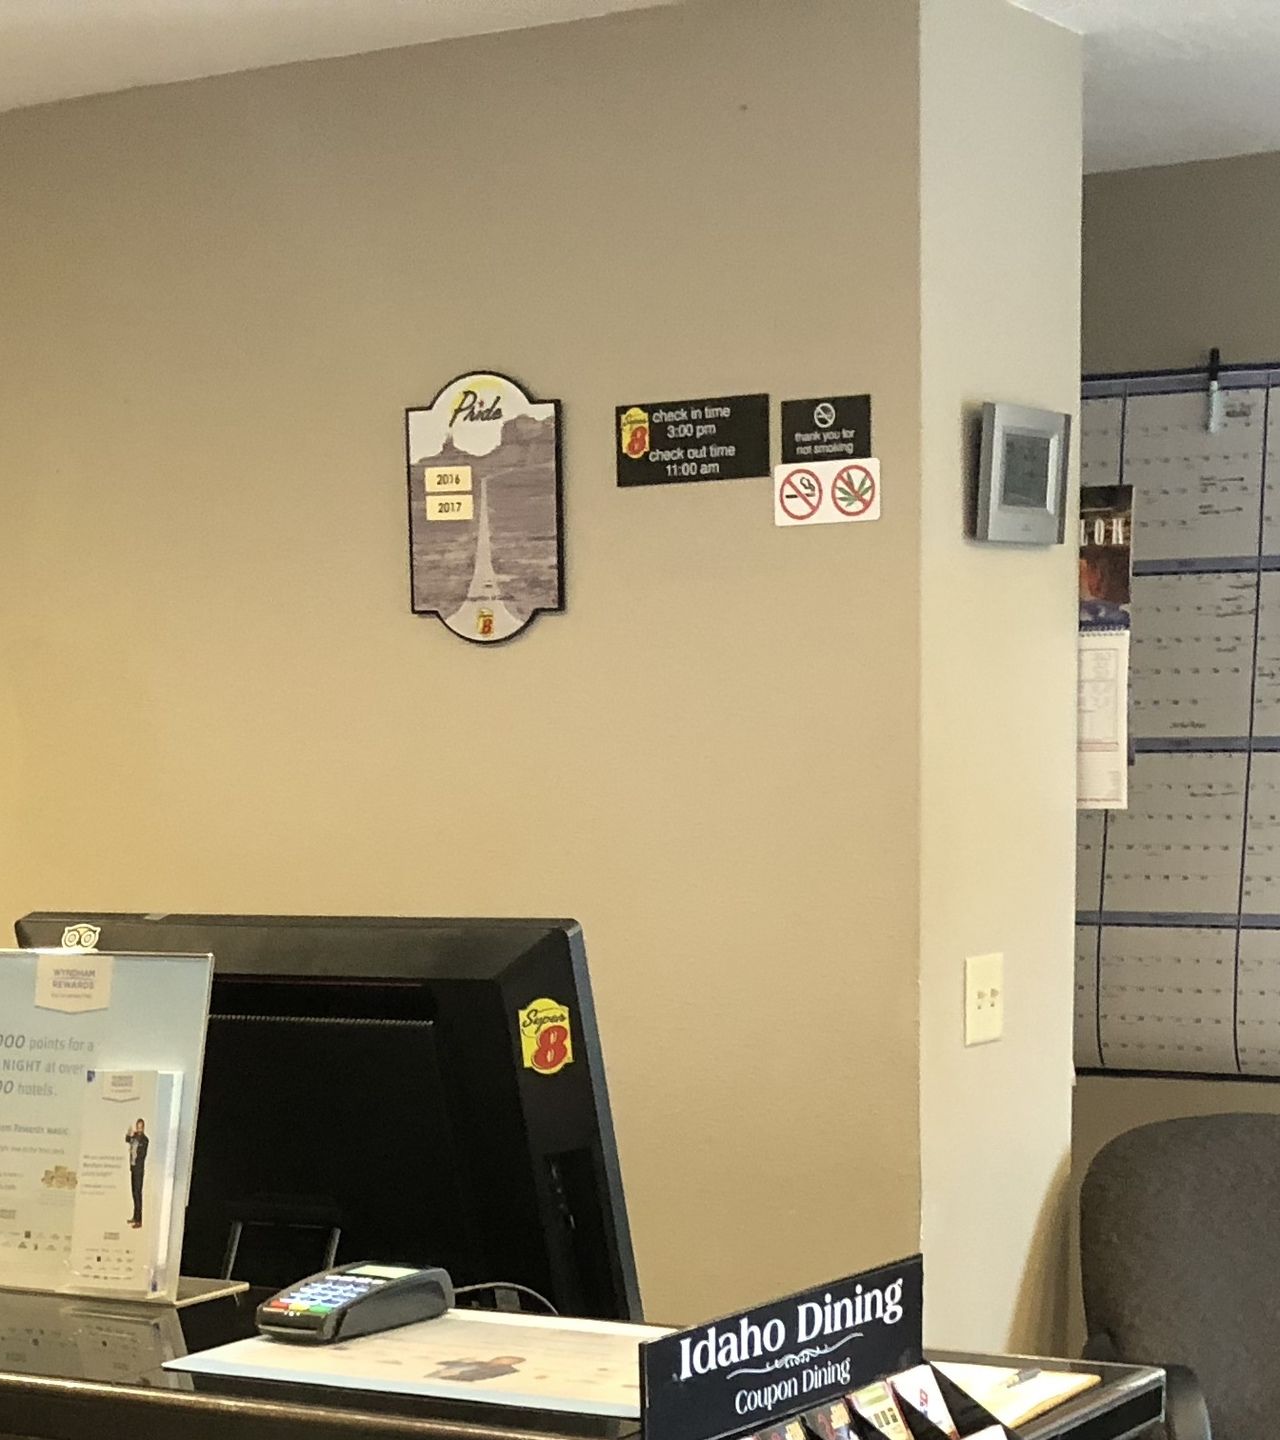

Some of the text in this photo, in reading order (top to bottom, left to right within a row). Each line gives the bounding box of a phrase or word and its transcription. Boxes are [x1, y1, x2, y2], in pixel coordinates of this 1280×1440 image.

[448, 389, 503, 428] Pride
[652, 405, 731, 423] check in time
[667, 424, 716, 438] 3:00 pm
[795, 430, 820, 442] thank
[823, 430, 840, 442] you
[628, 426, 648, 455] 8
[796, 442, 854, 455] not smoking
[649, 444, 736, 462] check out time
[666, 463, 720, 476] 11:00 am
[436, 474, 461, 485] 2016
[437, 502, 462, 513] 2017
[521, 1008, 567, 1034] Super
[29, 1036, 65, 1051] points
[68, 1037, 85, 1051] for
[87, 1041, 95, 1052] a
[531, 1025, 568, 1071] 8
[2, 1059, 41, 1072] NIGHT
[44, 1061, 57, 1072] at
[59, 1063, 84, 1073] over
[679, 1277, 904, 1381] Idaho Dining
[734, 1357, 852, 1415] Coupon Dining
